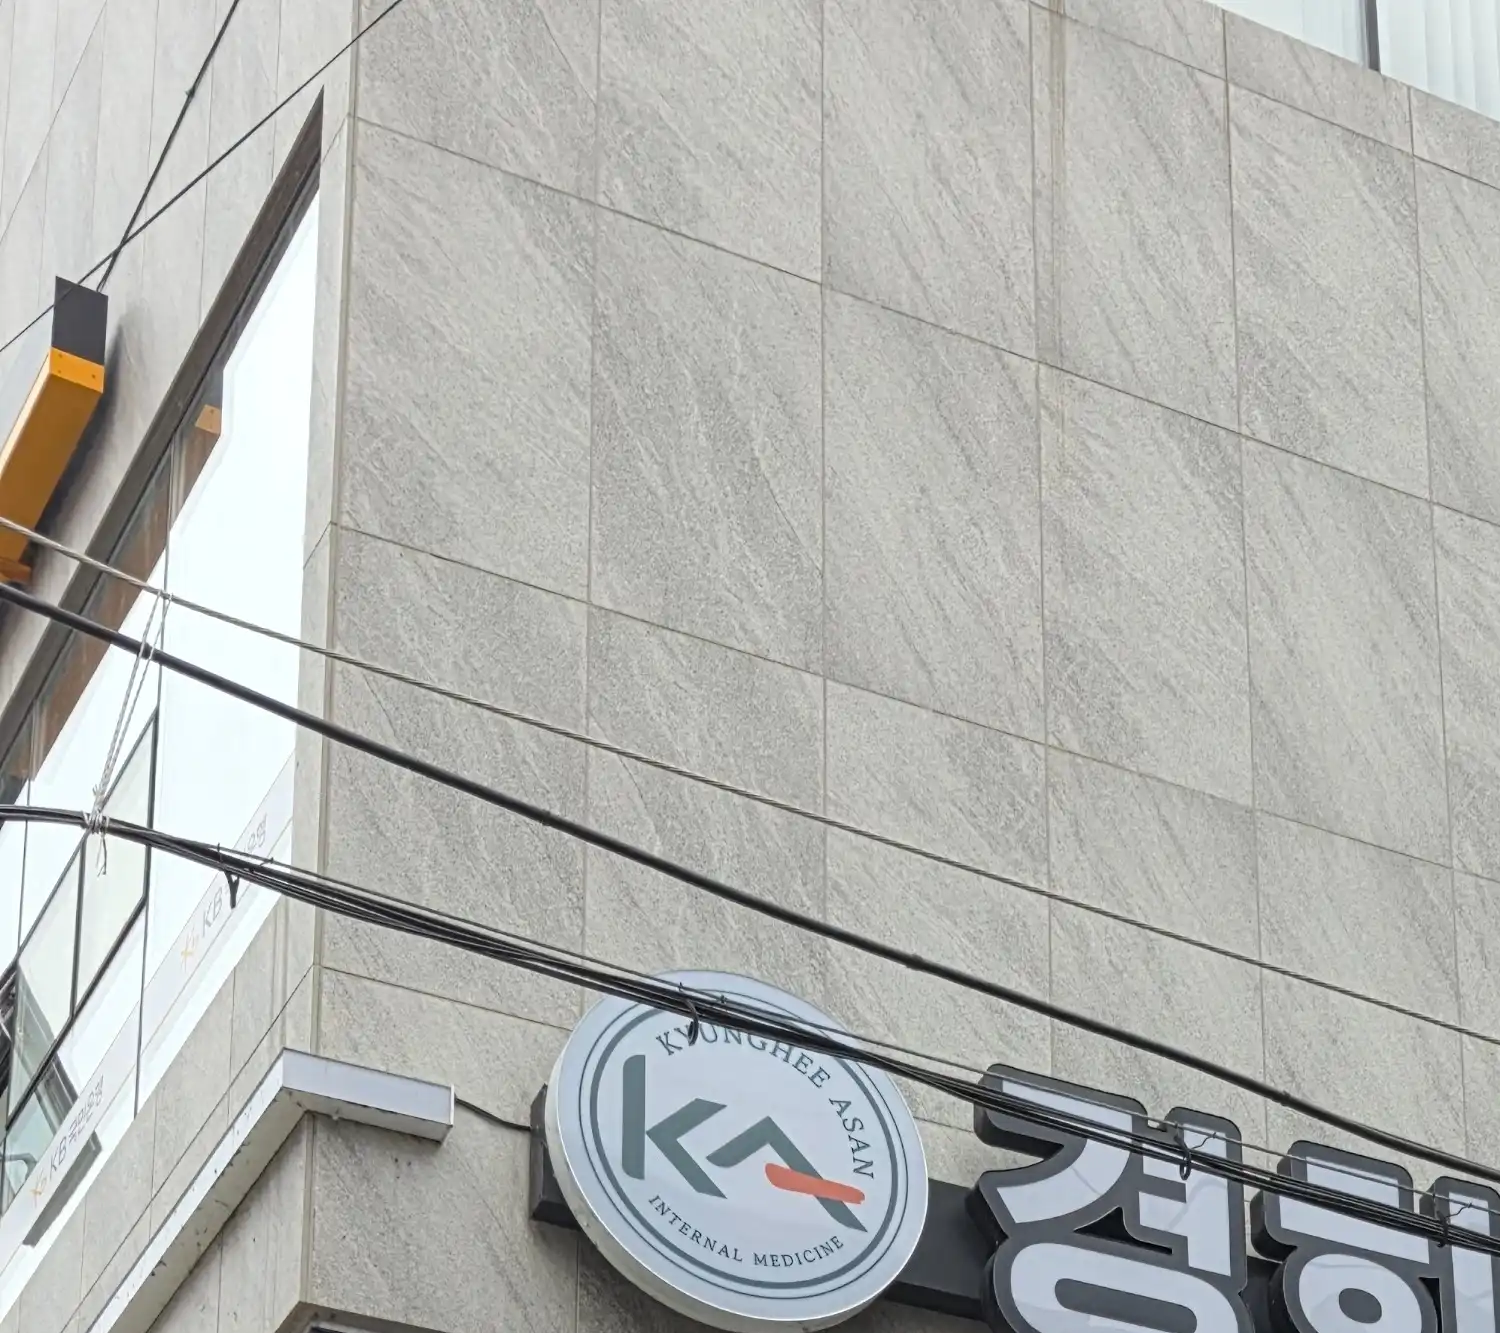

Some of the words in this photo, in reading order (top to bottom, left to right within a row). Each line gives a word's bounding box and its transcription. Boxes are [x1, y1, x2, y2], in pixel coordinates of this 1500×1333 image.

[828, 1096, 875, 1179] ASAN
[647, 1193, 744, 1262] INTERNAL
[753, 1234, 845, 1267] MEDICINE
